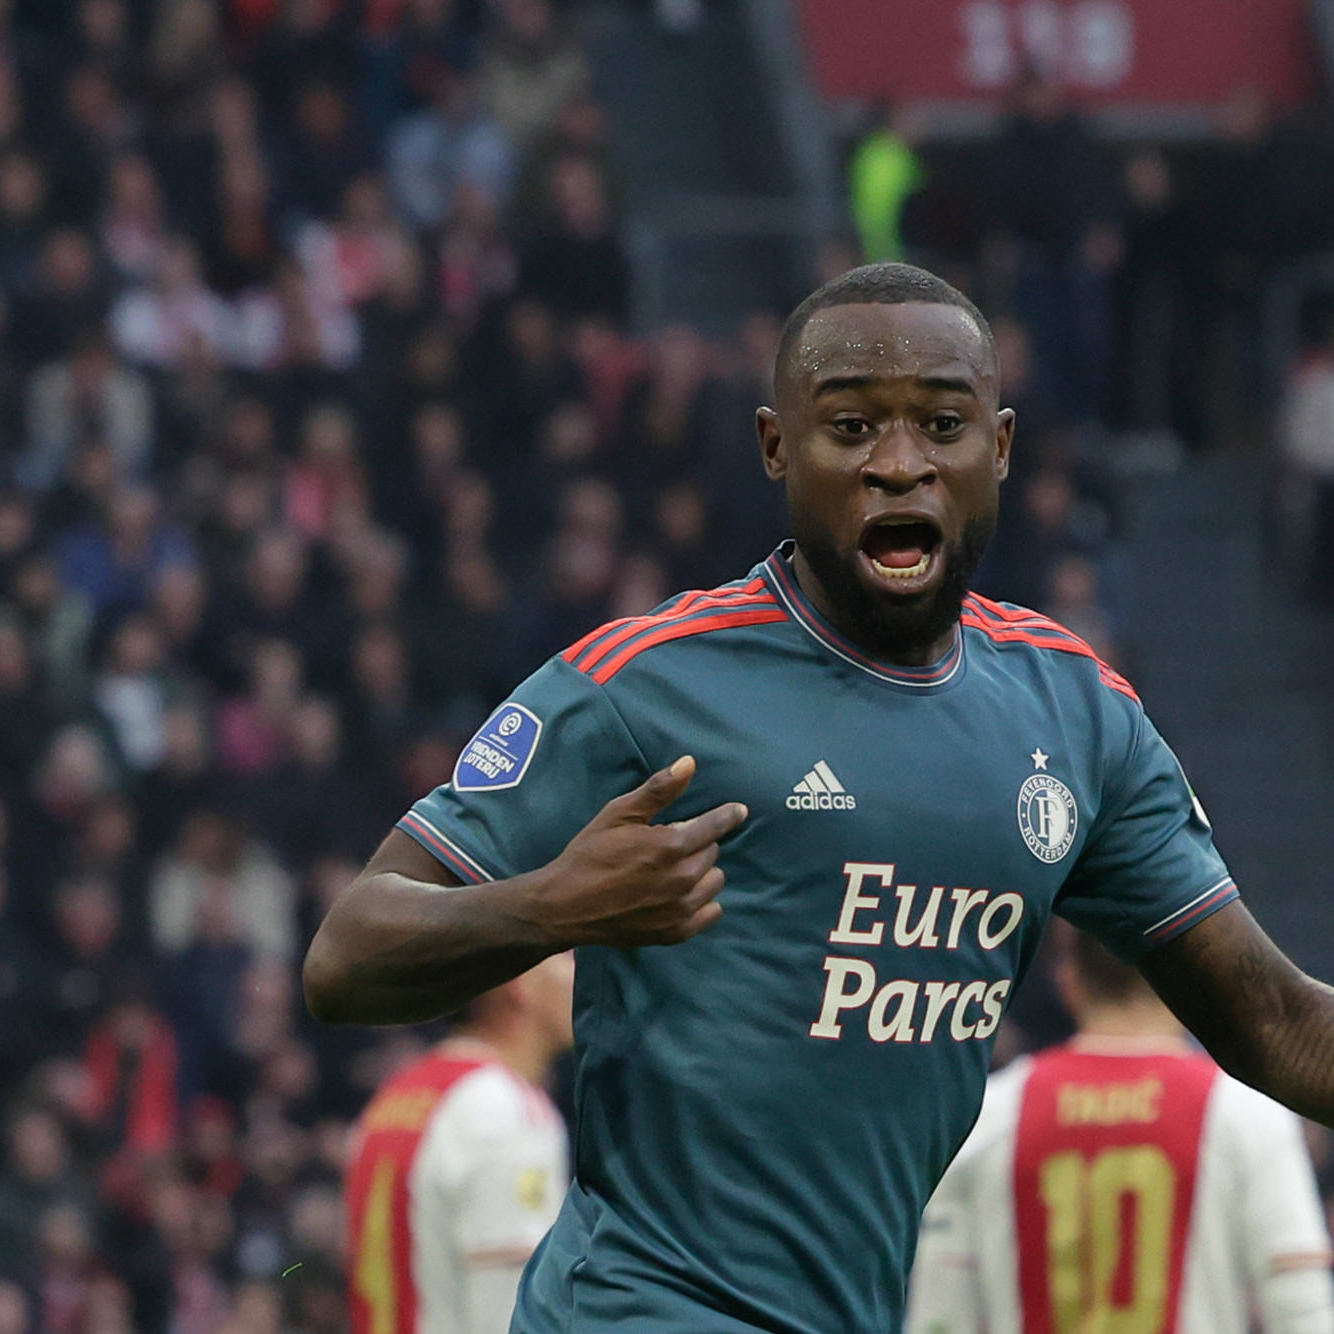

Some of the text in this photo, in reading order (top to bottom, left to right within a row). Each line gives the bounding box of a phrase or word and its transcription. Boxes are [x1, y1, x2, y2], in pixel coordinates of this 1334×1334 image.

[785, 790, 856, 811] adidas
[1022, 777, 1073, 808] FEYENOORD
[1024, 827, 1072, 860] ROTTERDAM
[827, 862, 1025, 951] Euro
[808, 955, 1012, 1044] Parcs
